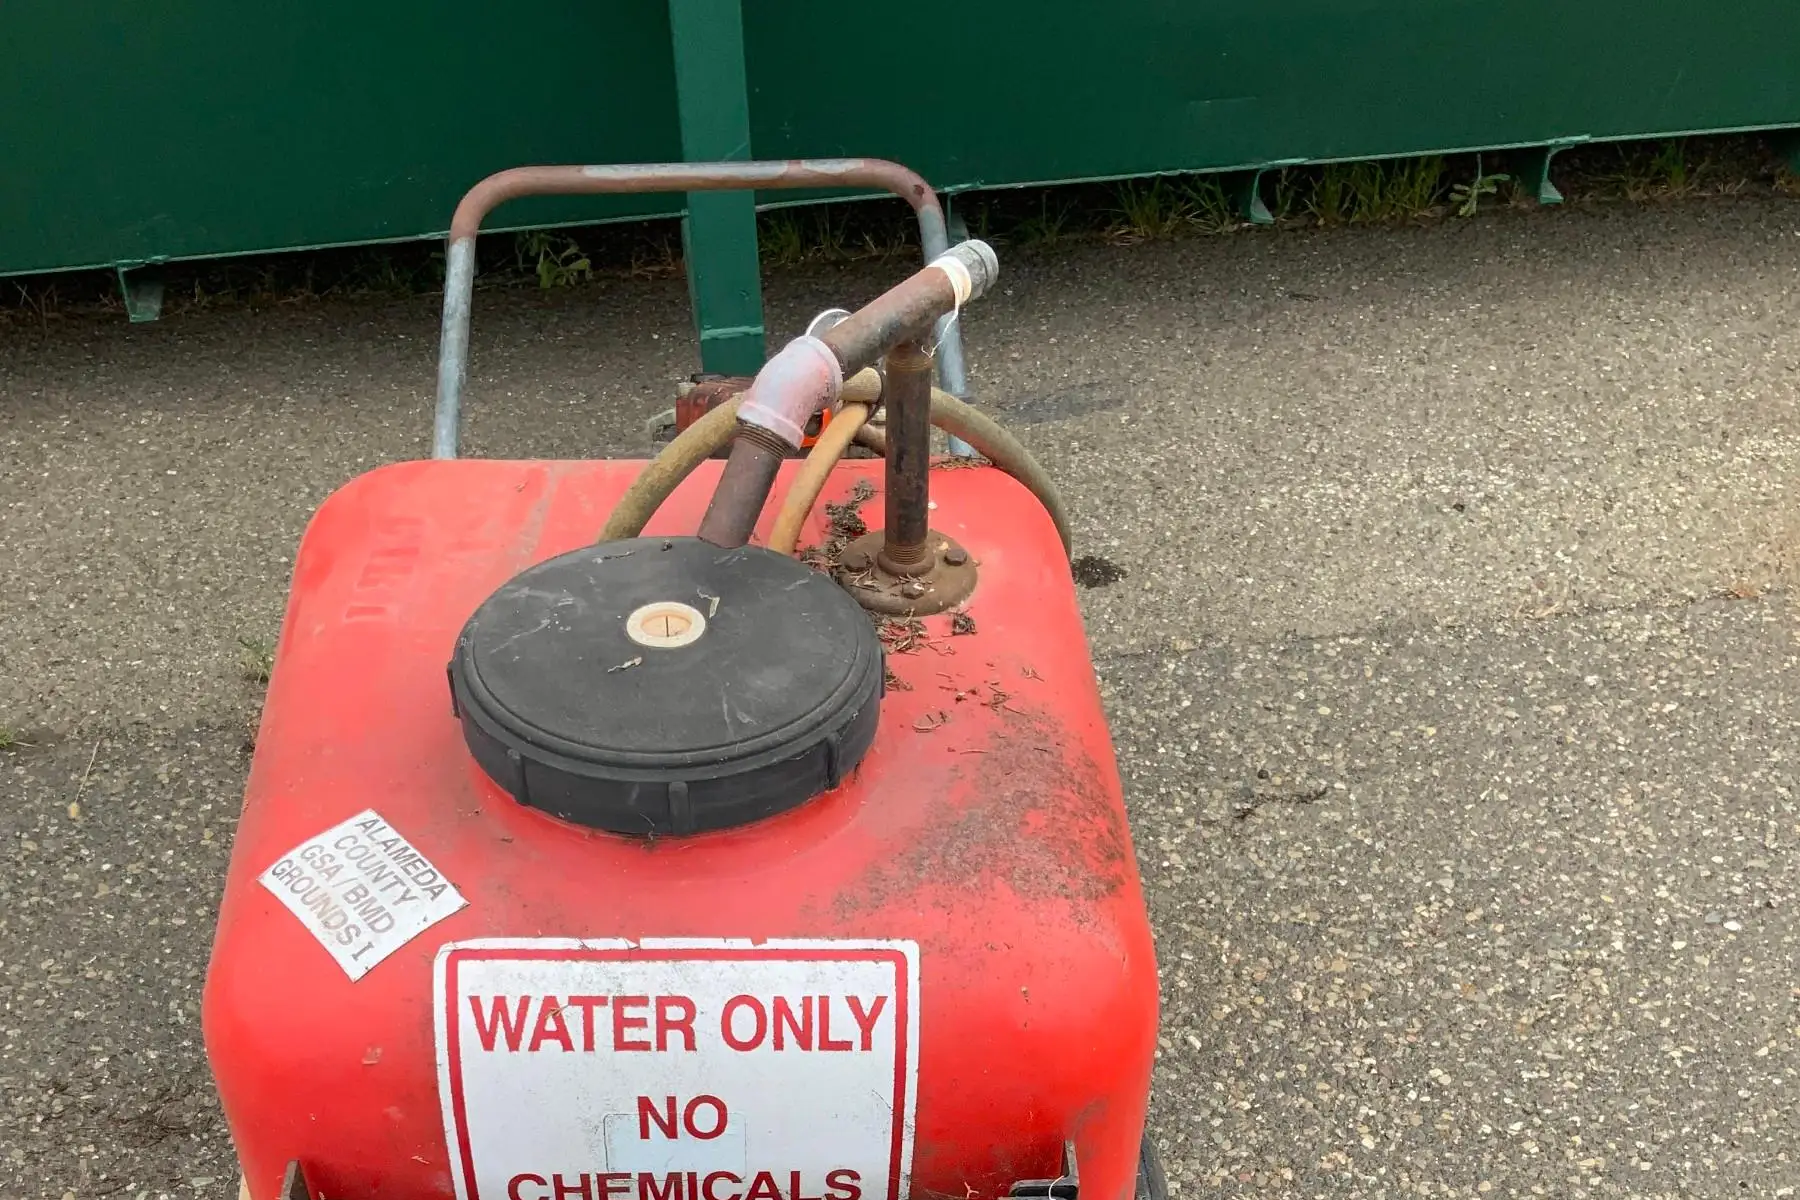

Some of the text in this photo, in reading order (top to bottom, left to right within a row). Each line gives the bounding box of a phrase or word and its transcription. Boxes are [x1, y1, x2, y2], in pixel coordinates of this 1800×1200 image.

[333, 834, 419, 906] COUNTY
[354, 817, 449, 902] ALAMEDA
[271, 858, 362, 946] GROUNDS
[468, 993, 888, 1053] WATER ONLY
[636, 1094, 729, 1140] NO
